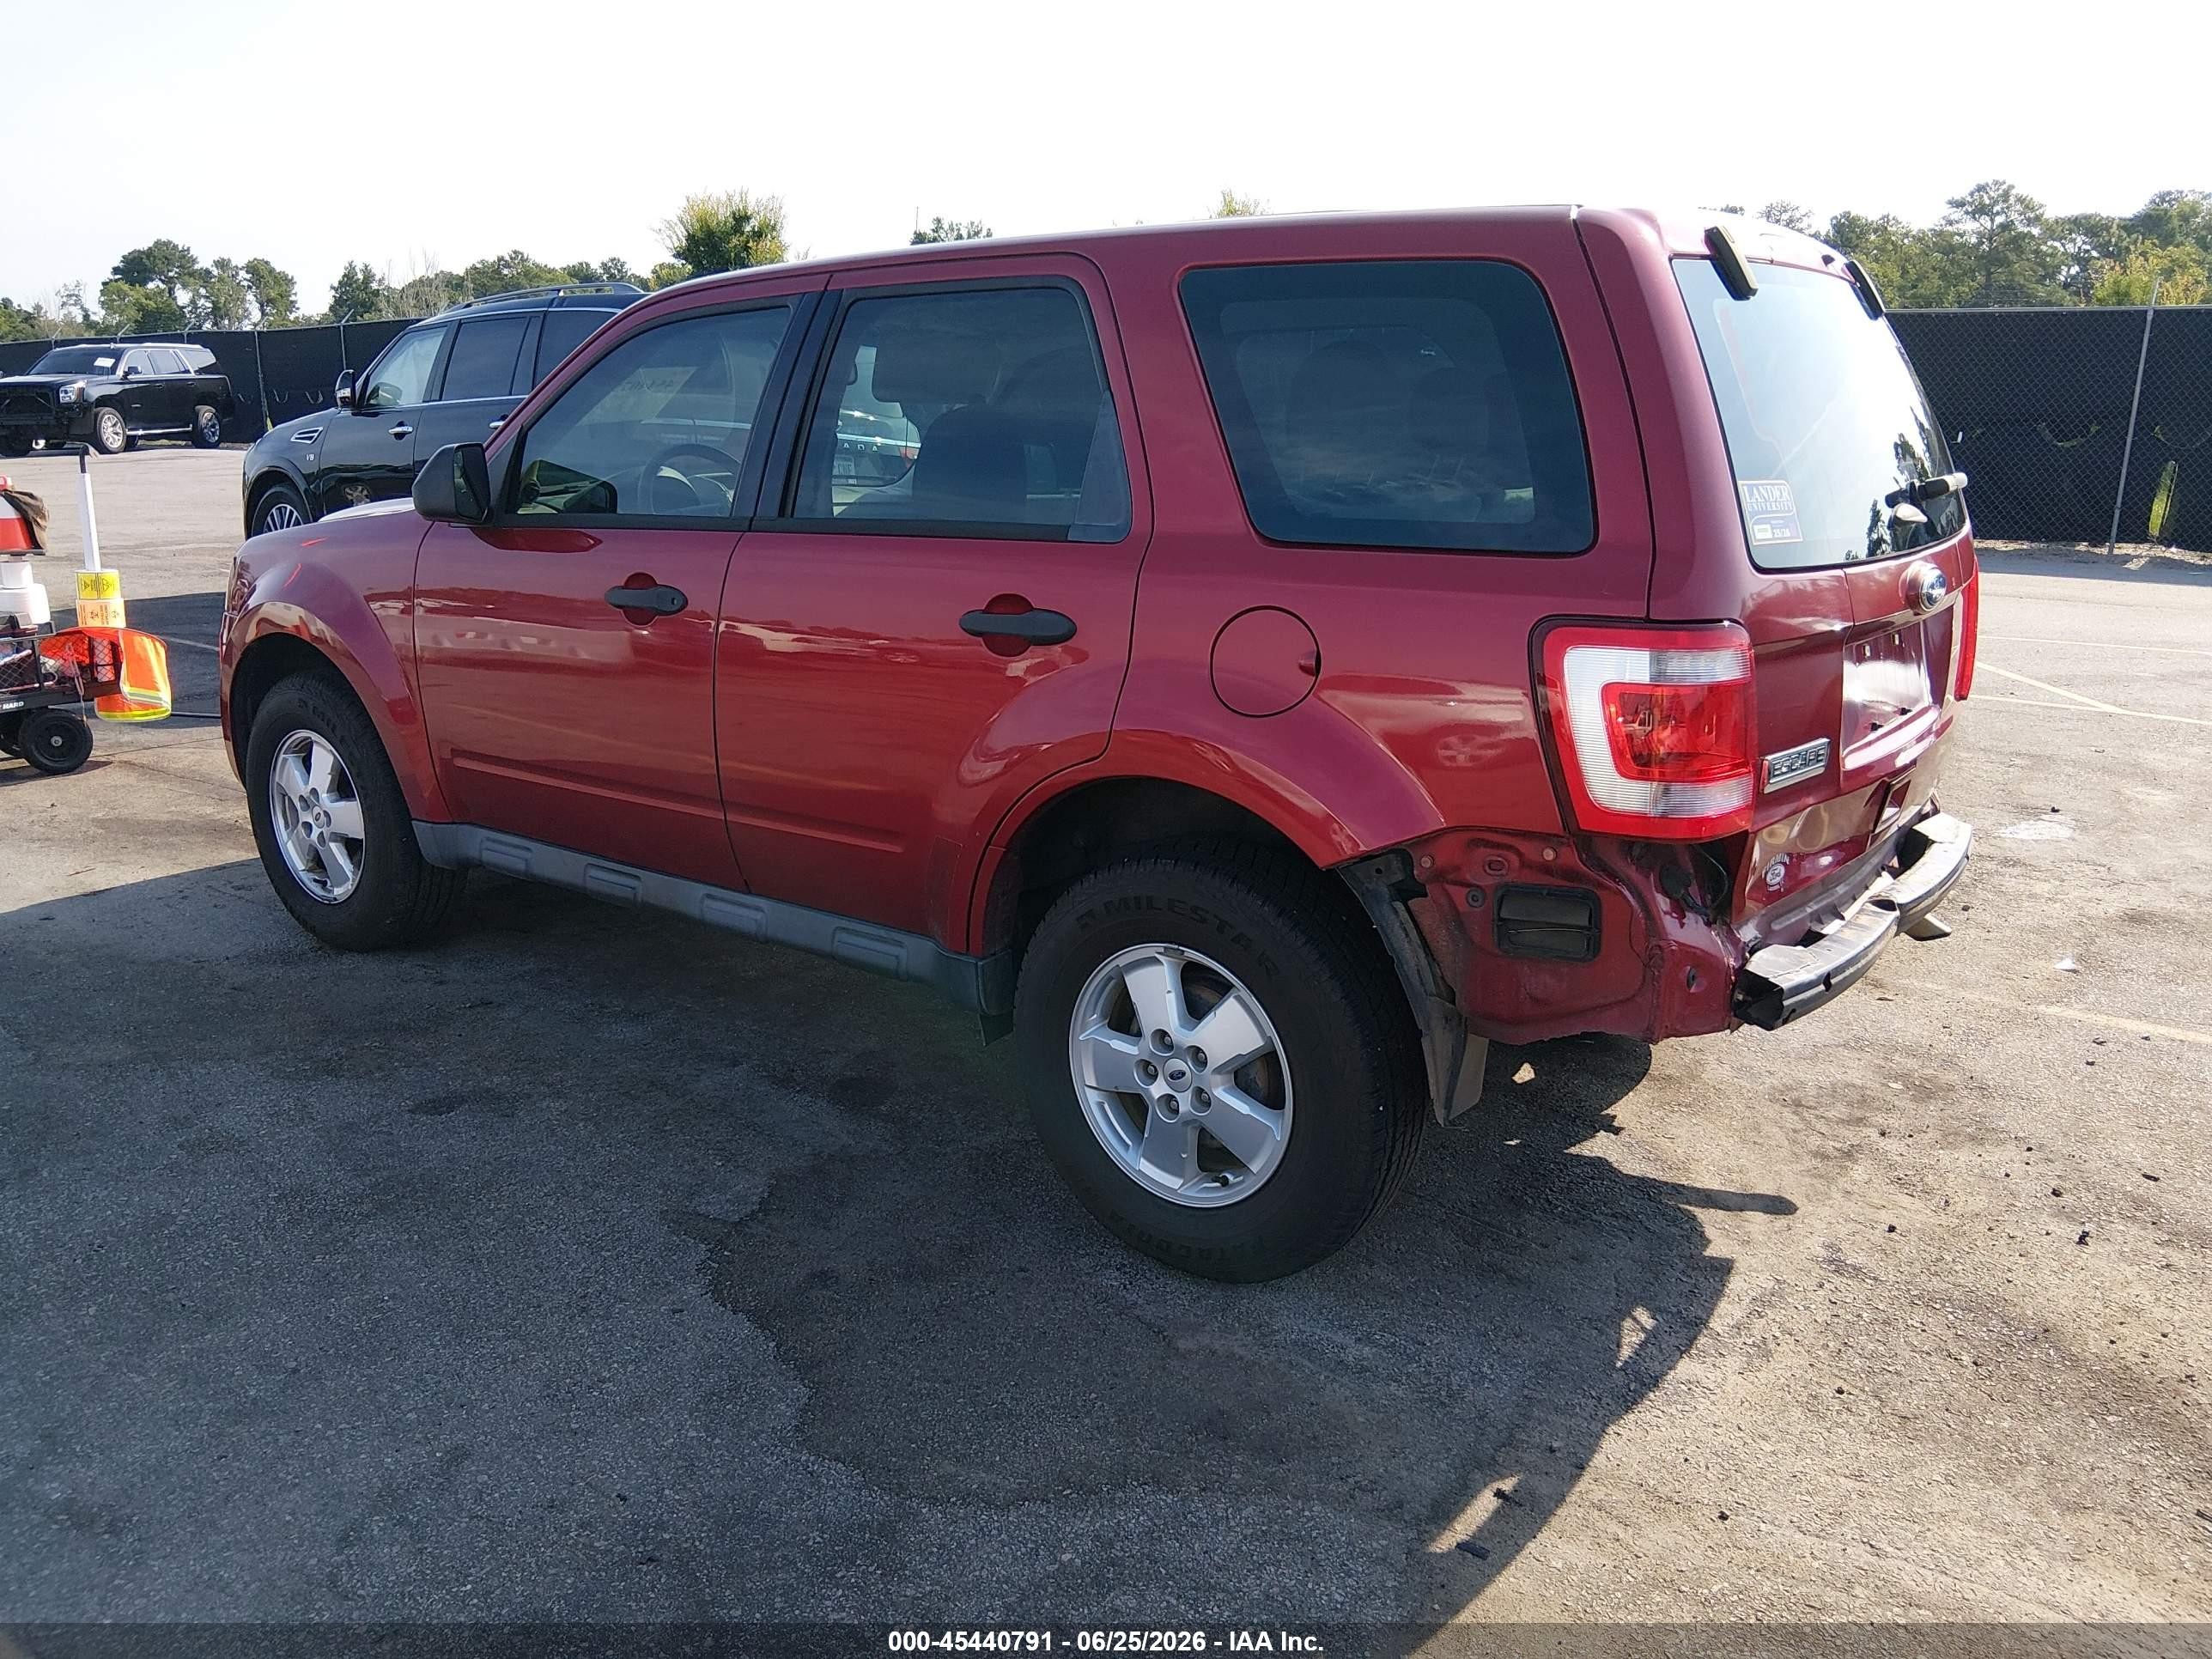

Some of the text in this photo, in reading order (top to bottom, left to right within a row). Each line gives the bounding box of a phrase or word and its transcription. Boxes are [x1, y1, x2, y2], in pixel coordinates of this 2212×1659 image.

[1742, 485, 1791, 501] LANDER
[1747, 501, 1793, 512] UNIVERSITY
[1771, 745, 1826, 777] ESCAPE
